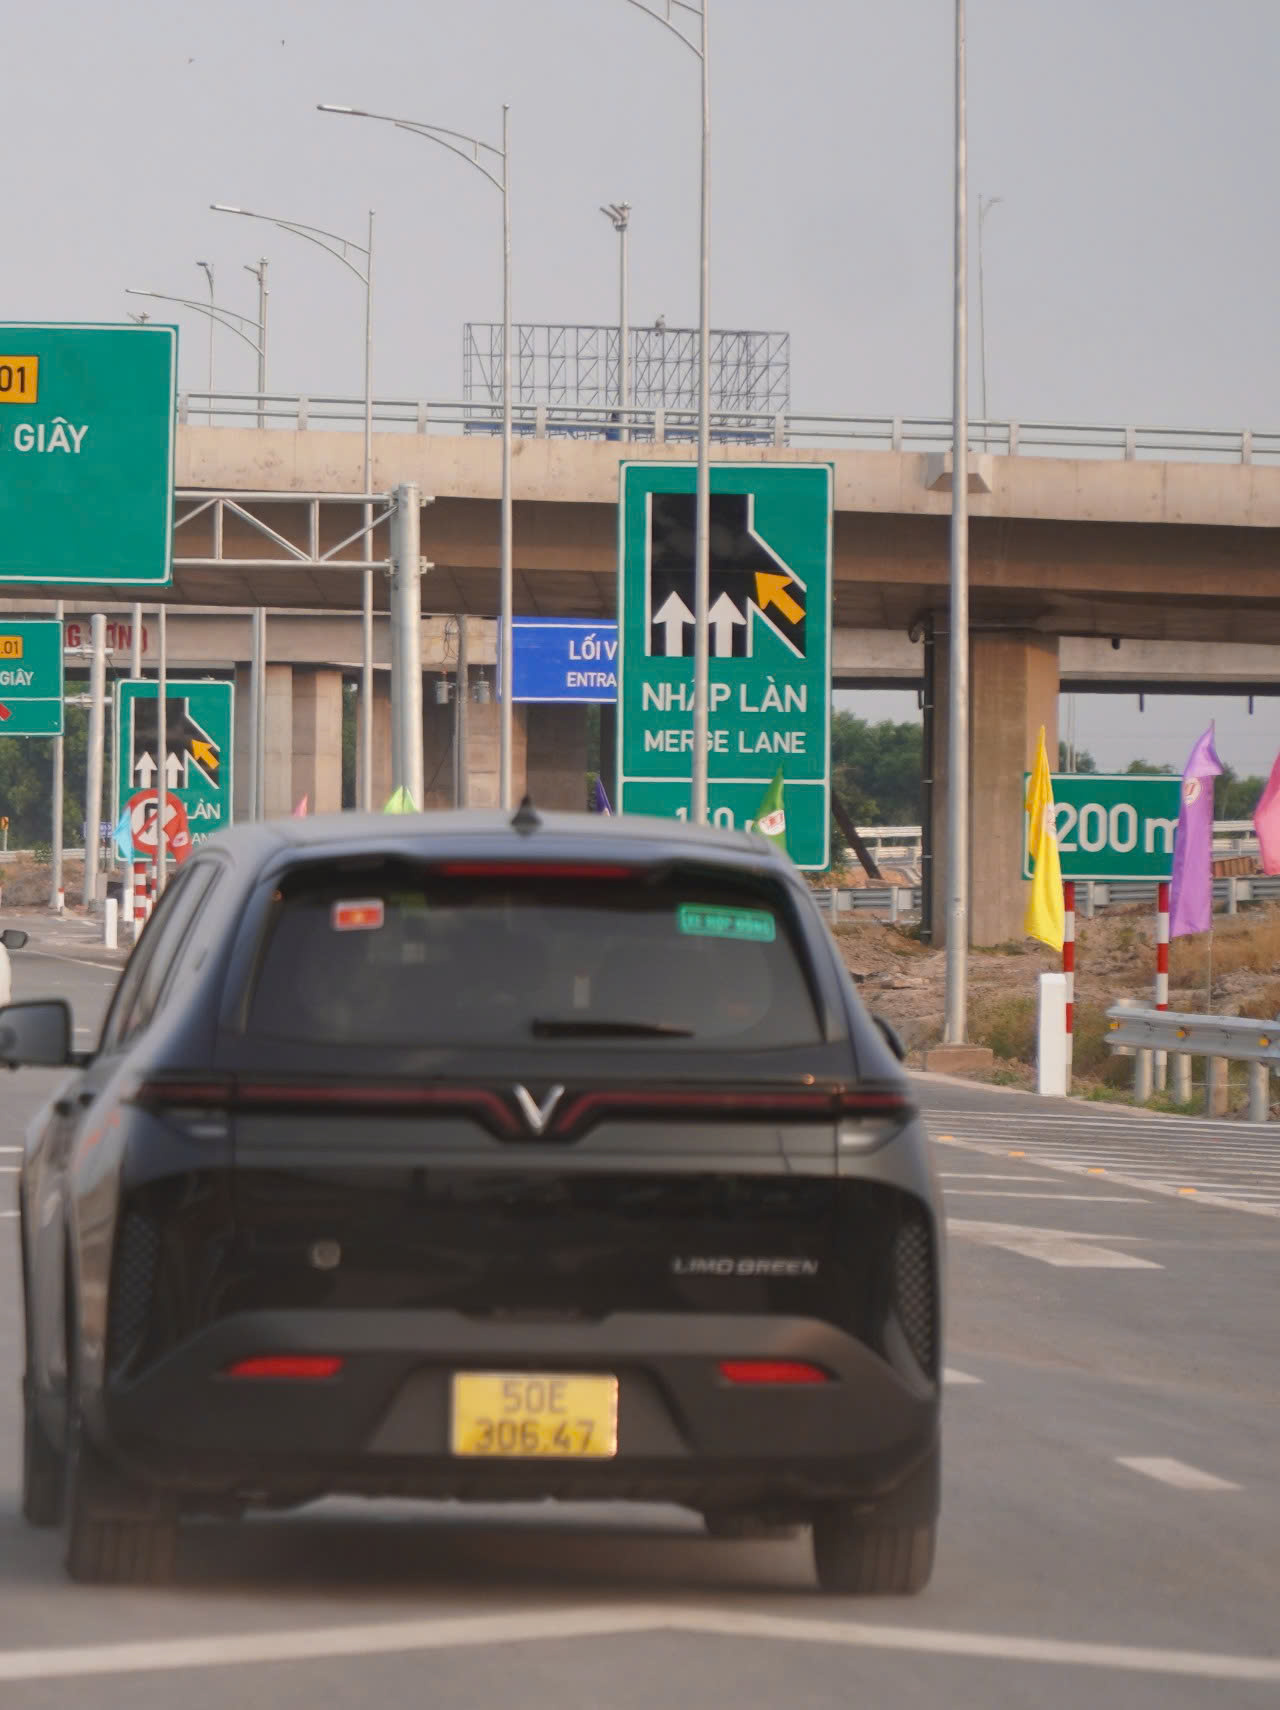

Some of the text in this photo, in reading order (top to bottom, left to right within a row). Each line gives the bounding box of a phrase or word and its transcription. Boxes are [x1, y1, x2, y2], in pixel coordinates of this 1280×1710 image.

[14, 416, 89, 454] GIÂY
[569, 632, 601, 660] LỐI
[0, 668, 34, 687] GIÂY
[567, 672, 618, 687] ENTRA
[740, 675, 807, 713] LÀN
[739, 730, 807, 753] LANE
[1055, 802, 1138, 853] 200
[672, 1256, 819, 1275] LIMO GREEN
[503, 1379, 568, 1414] 50E
[475, 1417, 595, 1452] 306.47
